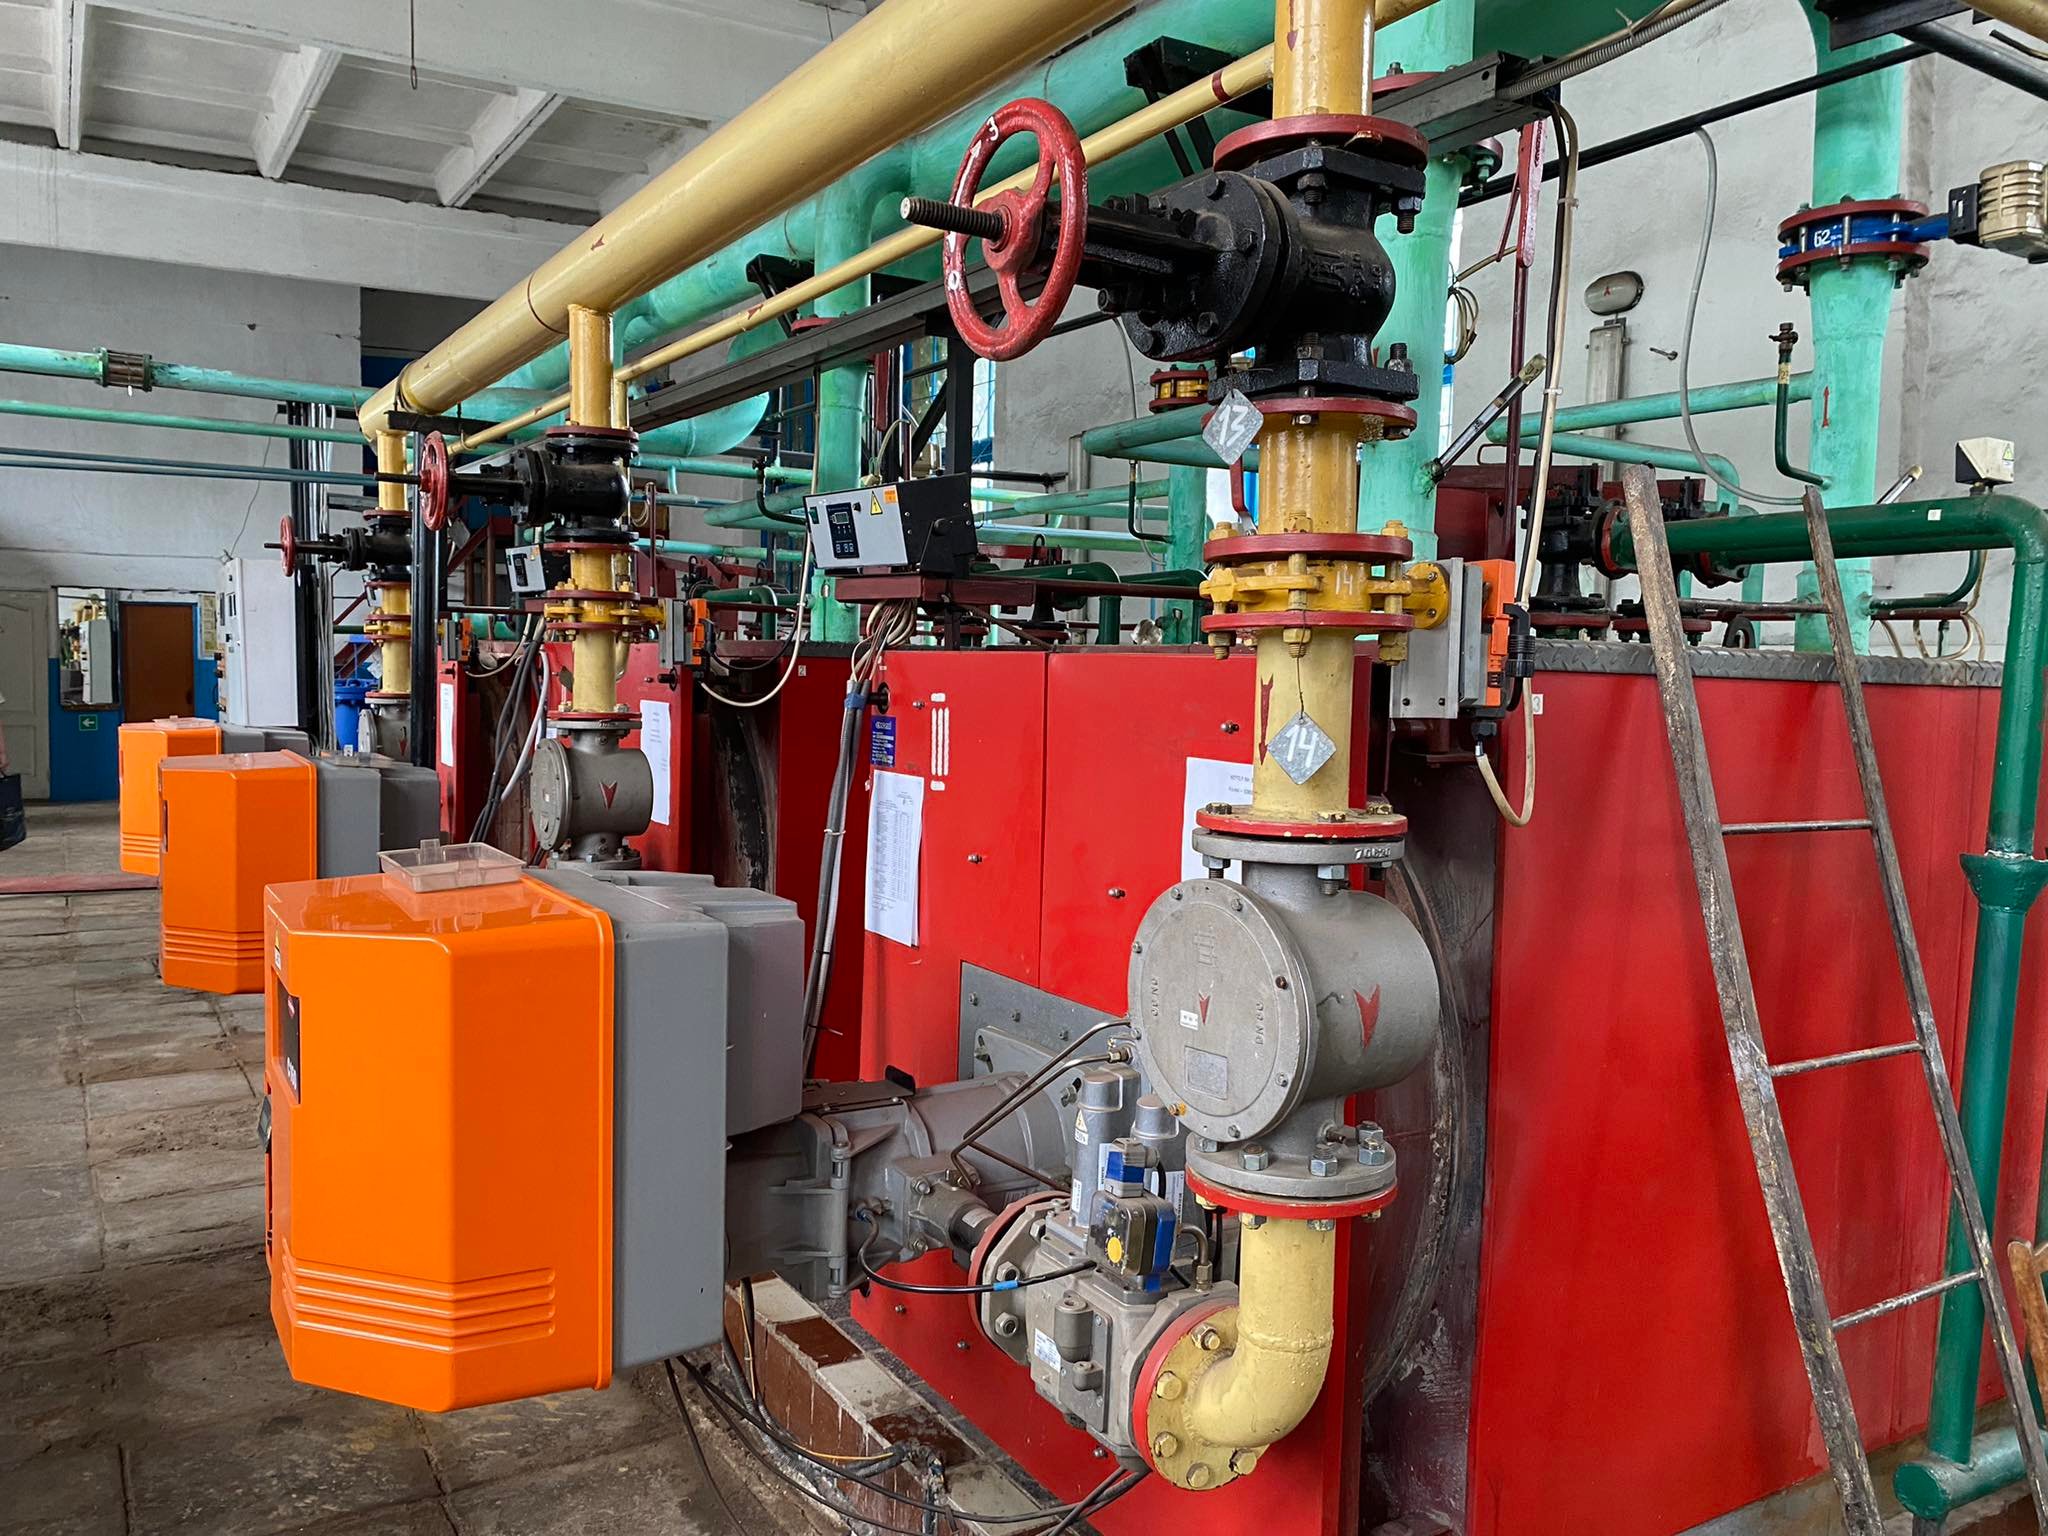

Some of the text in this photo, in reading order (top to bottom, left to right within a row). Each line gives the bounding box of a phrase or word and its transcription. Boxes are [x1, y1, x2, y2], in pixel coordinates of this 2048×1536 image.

[1219, 404, 1249, 447] 13
[1336, 564, 1353, 595] 14
[1285, 725, 1319, 768] 14
